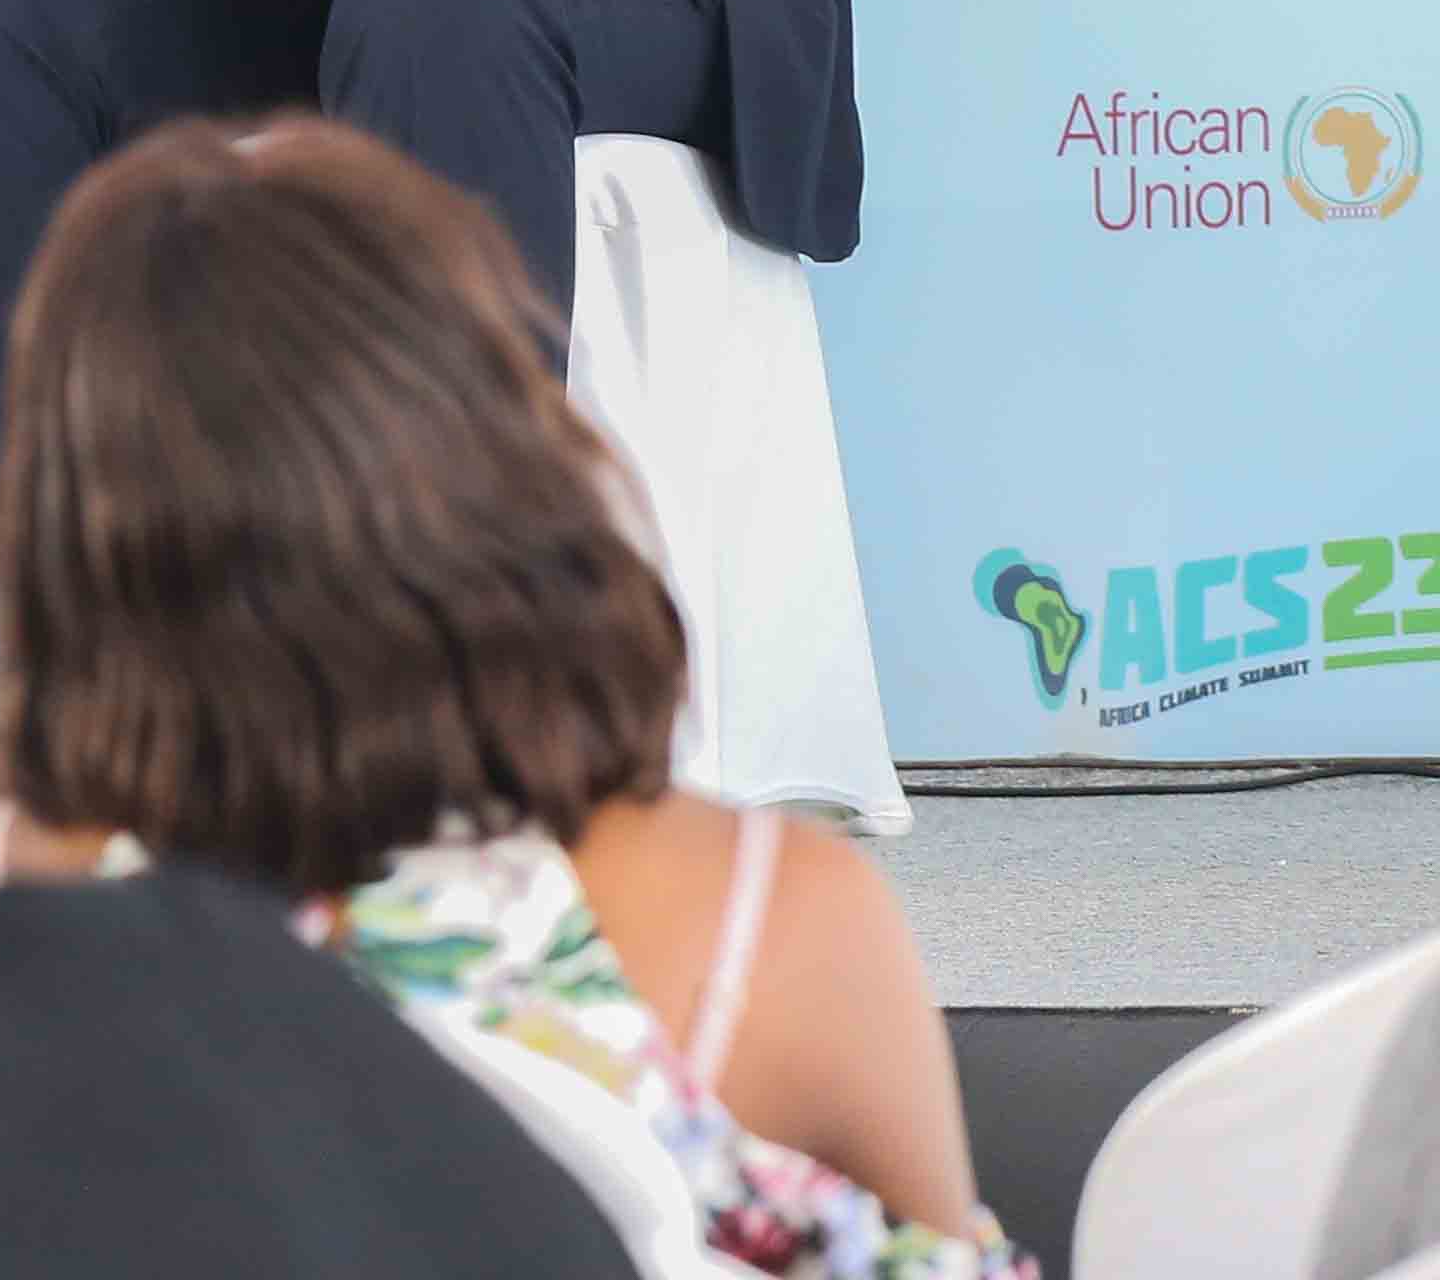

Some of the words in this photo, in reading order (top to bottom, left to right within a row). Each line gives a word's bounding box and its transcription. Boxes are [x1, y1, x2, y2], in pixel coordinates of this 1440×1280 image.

[1056, 91, 1269, 157] African
[1093, 165, 1270, 231] Union
[1099, 532, 1440, 691] ACS23
[1099, 701, 1150, 728] AFRICA
[1159, 676, 1229, 712] CLIMATE
[1239, 660, 1311, 688] SUMMIT
